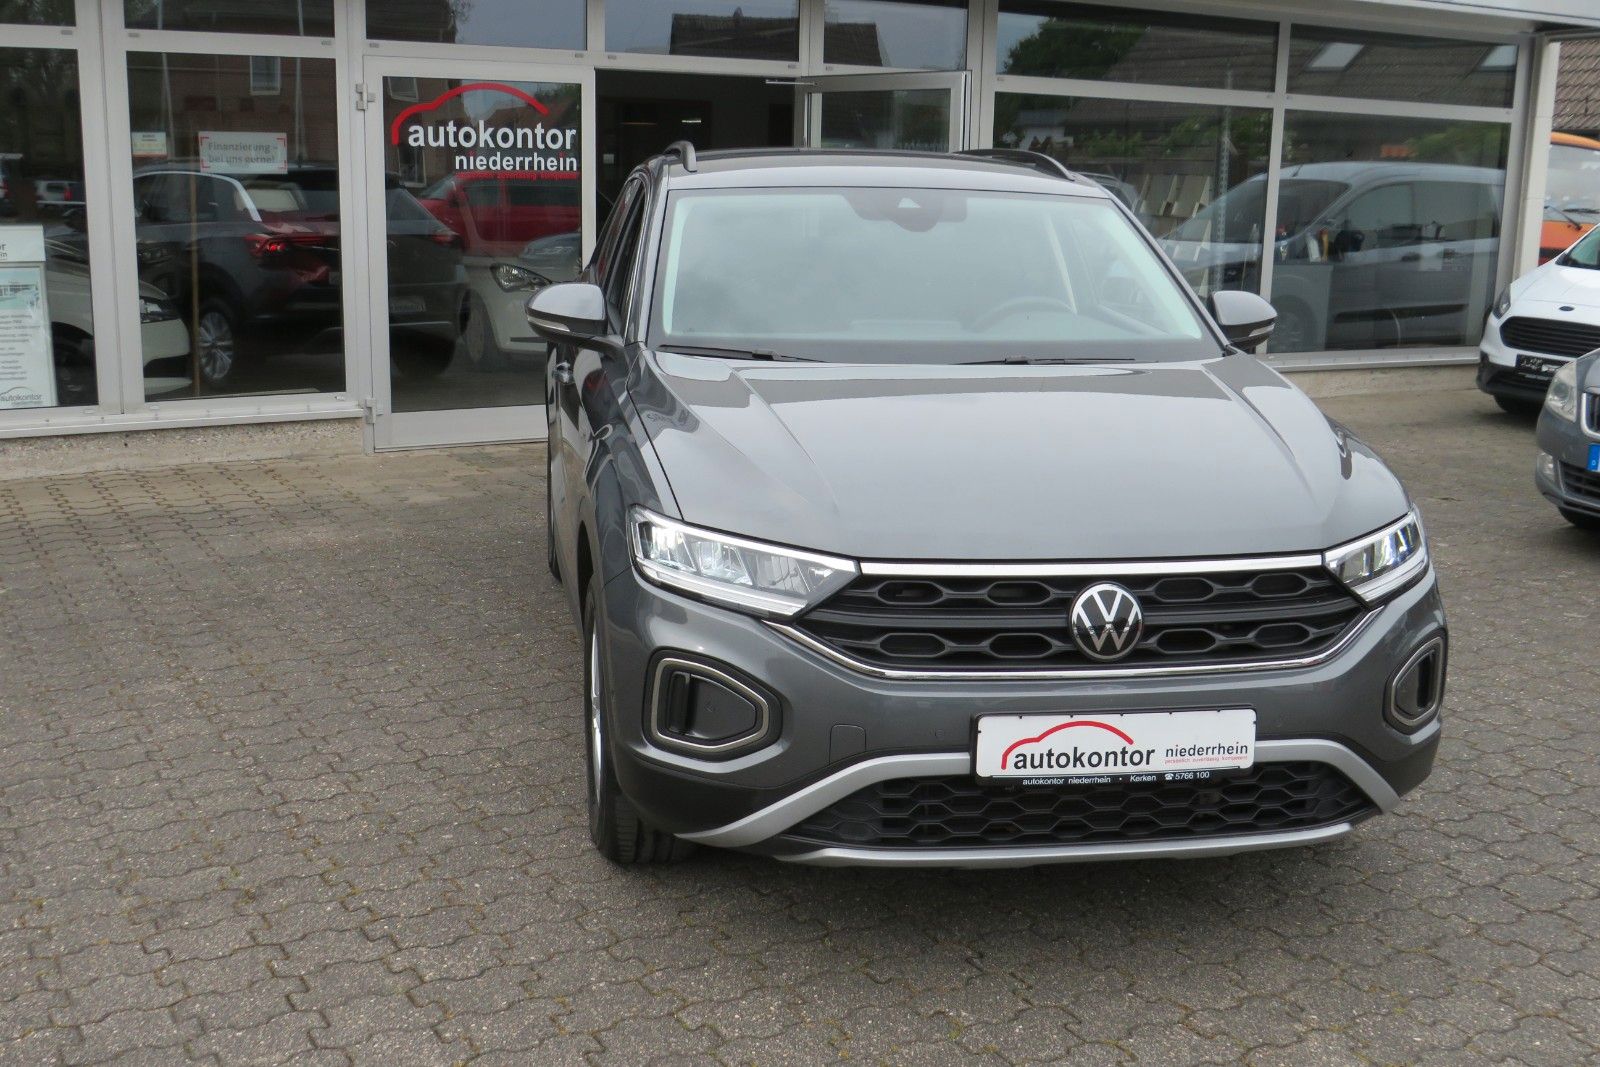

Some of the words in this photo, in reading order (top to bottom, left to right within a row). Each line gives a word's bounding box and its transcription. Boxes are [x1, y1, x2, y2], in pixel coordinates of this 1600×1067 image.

[408, 120, 577, 149] autokontor
[455, 151, 577, 171] niederrhein
[1073, 586, 1140, 656] VW
[1013, 746, 1155, 770] autokontor
[1165, 741, 1249, 757] niederrhein
[1022, 777, 1065, 785] autokontor
[1068, 775, 1111, 784] niederrhein
[1130, 774, 1157, 783] Kerken
[1175, 772, 1194, 780] 5766
[1196, 771, 1210, 779] 100
